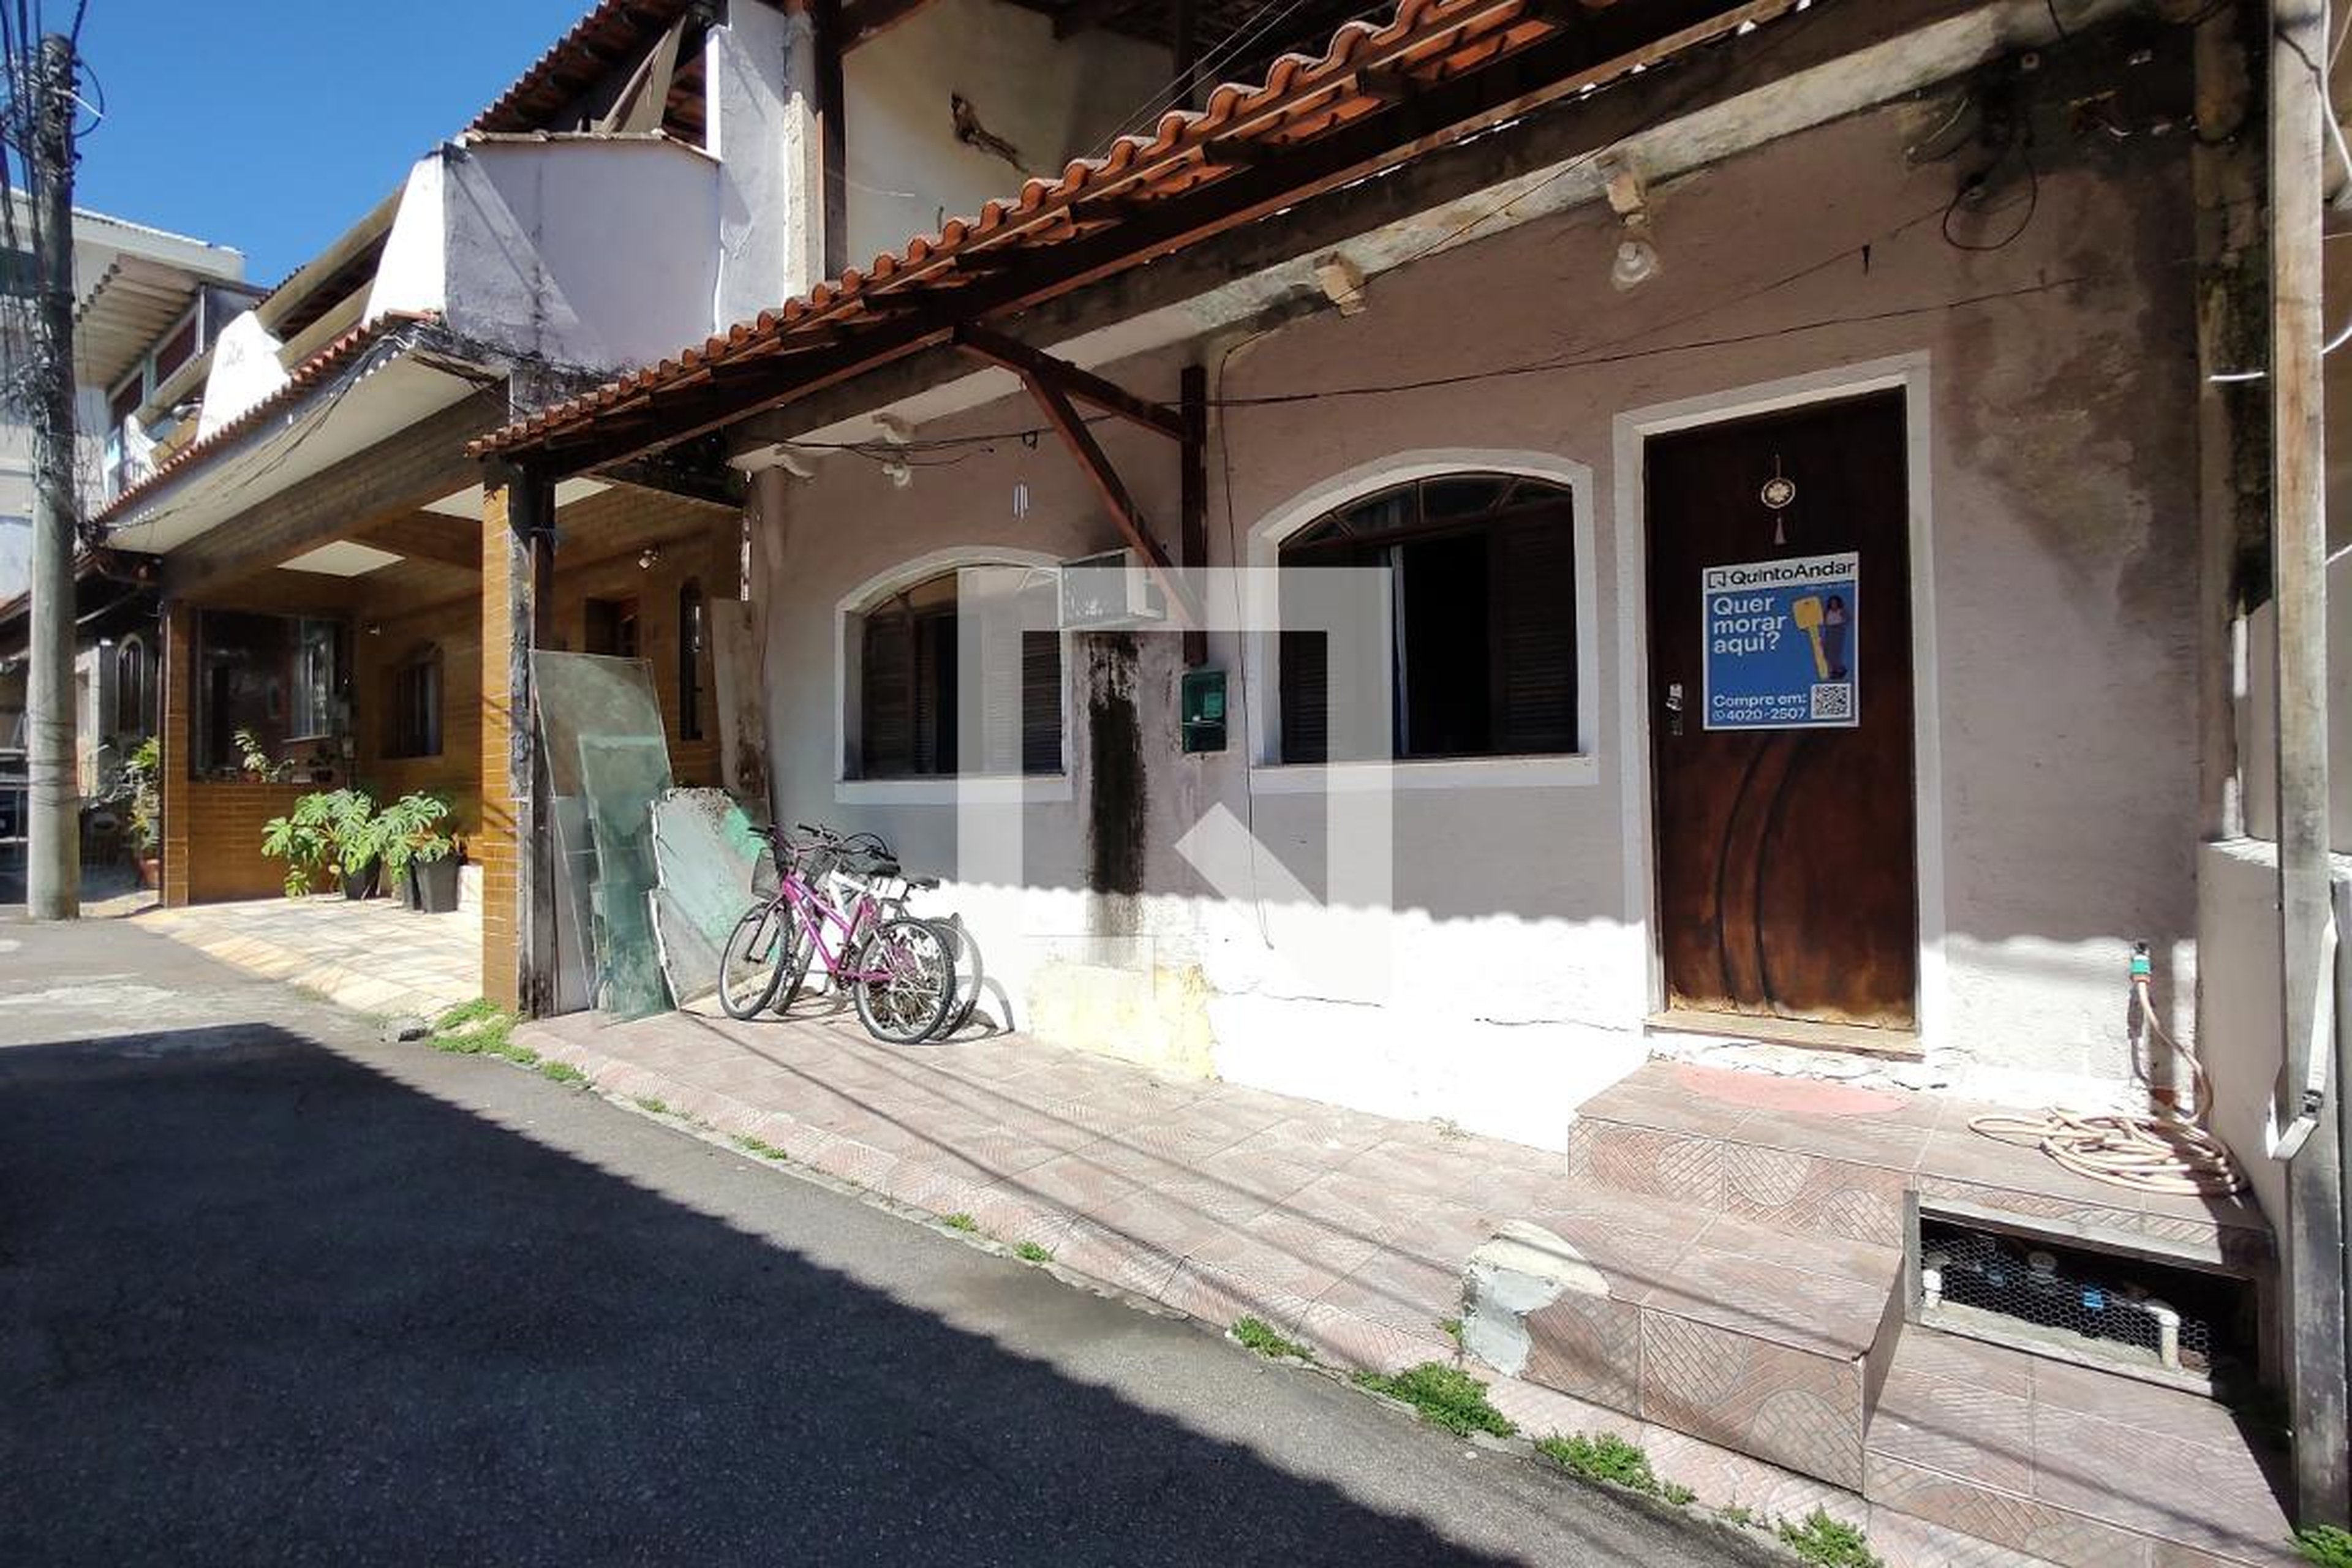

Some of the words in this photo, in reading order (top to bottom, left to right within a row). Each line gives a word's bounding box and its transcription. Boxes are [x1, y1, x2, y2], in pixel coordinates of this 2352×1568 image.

[1730, 560, 1855, 586] QuintoAndar
[1713, 596, 1775, 616] Quer
[1714, 615, 1788, 635] morar
[1714, 630, 1781, 657] aqui?
[1713, 694, 1774, 708] Compre
[1777, 693, 1807, 705] em:
